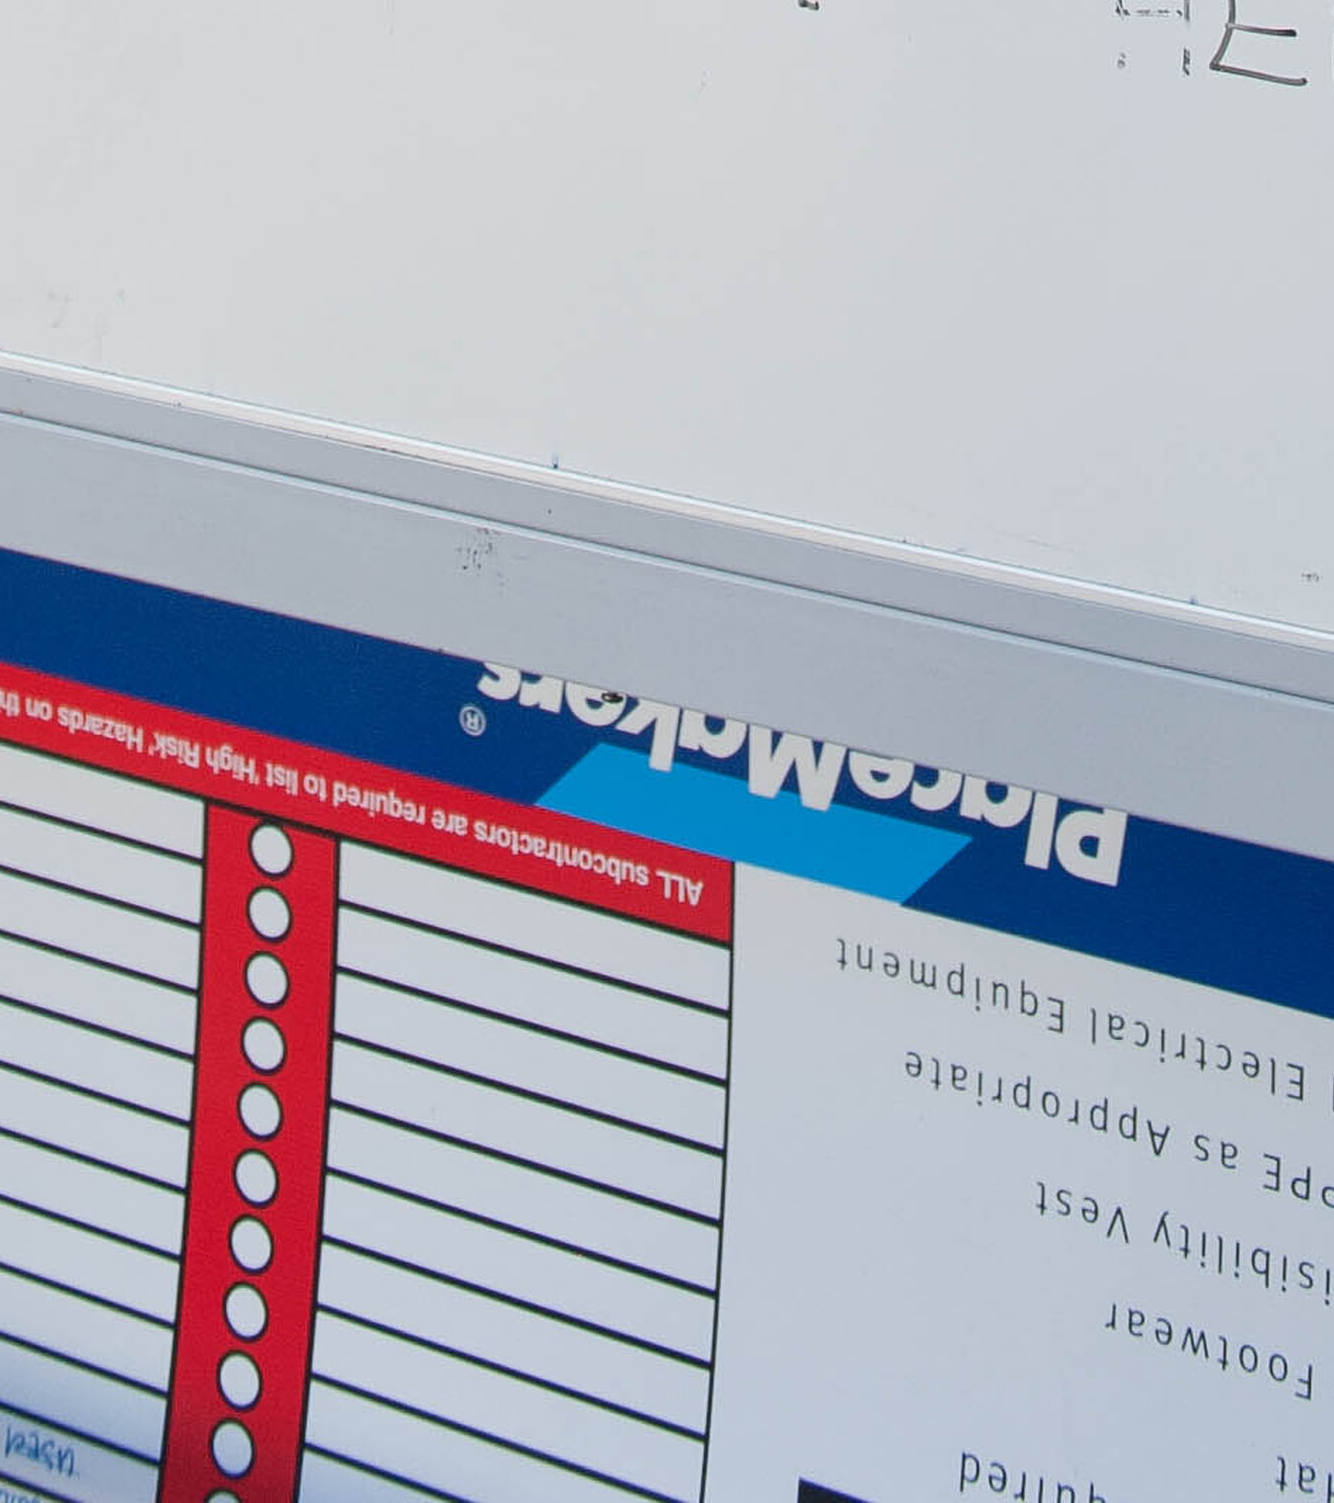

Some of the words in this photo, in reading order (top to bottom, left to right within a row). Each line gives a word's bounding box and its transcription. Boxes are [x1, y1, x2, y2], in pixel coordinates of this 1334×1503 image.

[24, 697, 53, 723] on
[56, 704, 145, 752] Hazards
[265, 762, 300, 795] list
[302, 774, 328, 803] to
[332, 781, 427, 827] required
[432, 809, 469, 840] are
[473, 819, 650, 887] subcontractors
[655, 870, 704, 907] ALL
[834, 937, 1066, 1037] Equipment
[1088, 1007, 1305, 1101] Electrical
[902, 1050, 1171, 1160] Appropriate
[1191, 1133, 1239, 1171] as
[1034, 1181, 1130, 1245] Vest
[1104, 1302, 1314, 1402] Footwear
